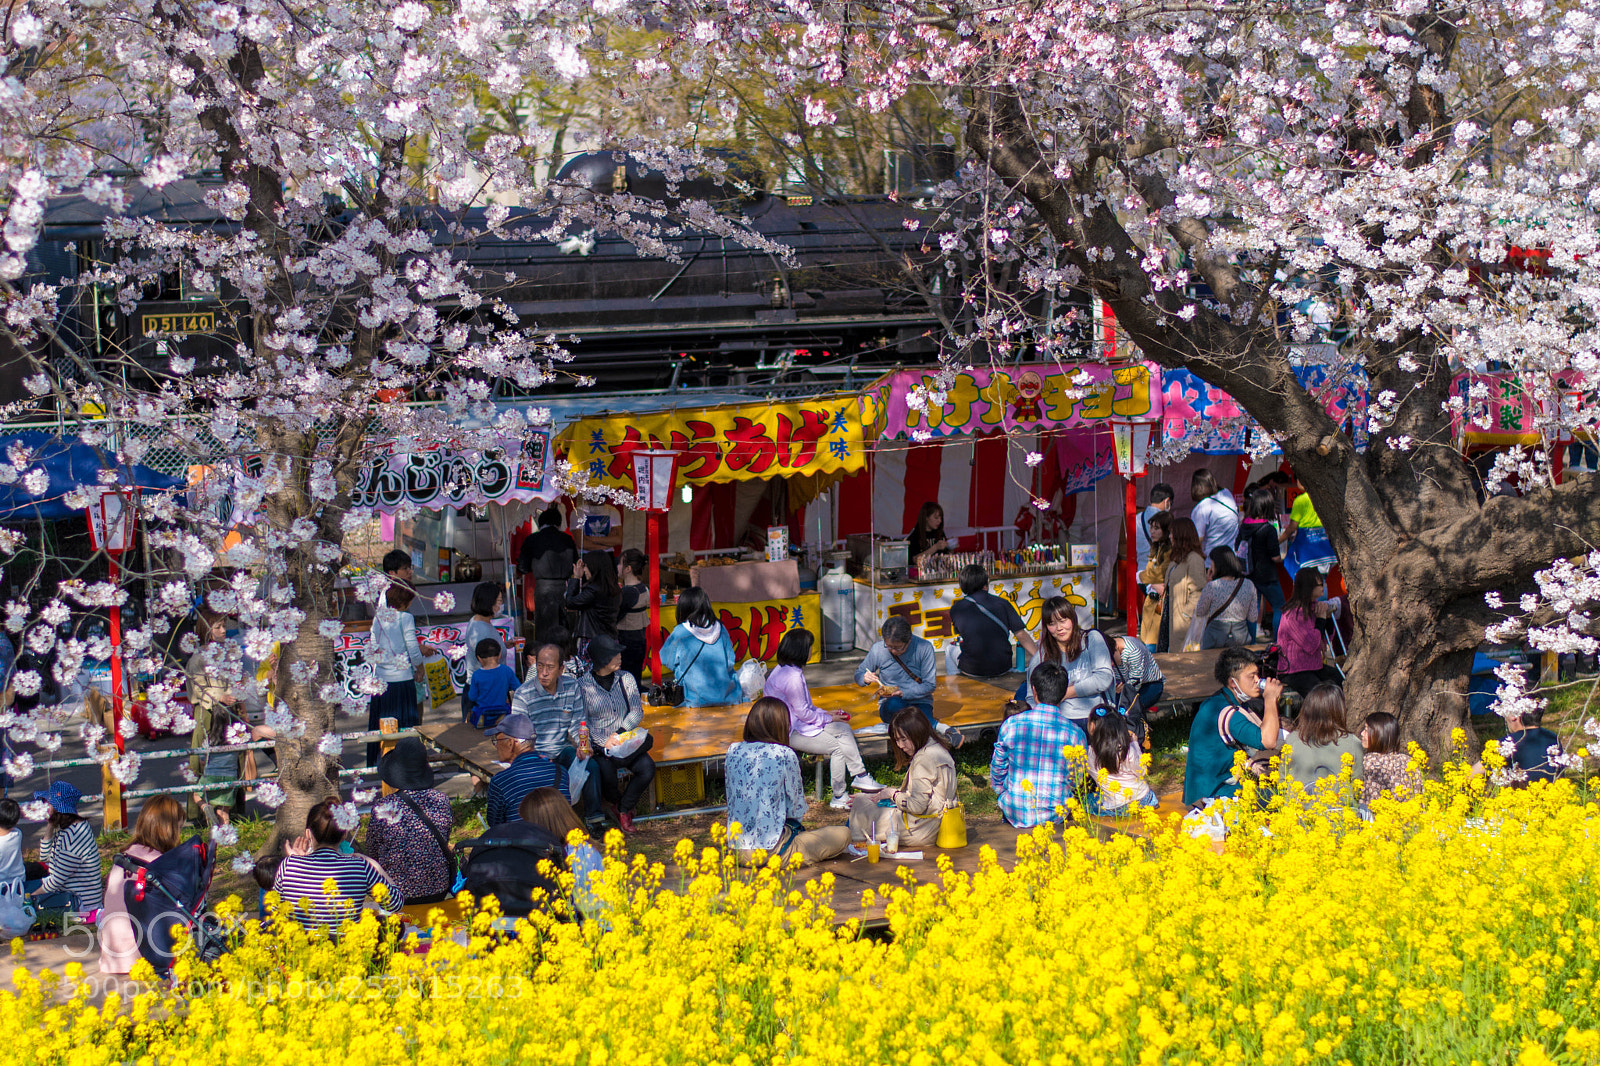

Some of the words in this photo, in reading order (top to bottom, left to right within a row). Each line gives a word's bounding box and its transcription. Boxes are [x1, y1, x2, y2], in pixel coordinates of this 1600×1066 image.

[1499, 377, 1523, 431] 特製
[588, 427, 609, 481] 美味
[607, 408, 830, 480] からあげ
[829, 406, 851, 462] 美味
[351, 446, 512, 507] んじゅう
